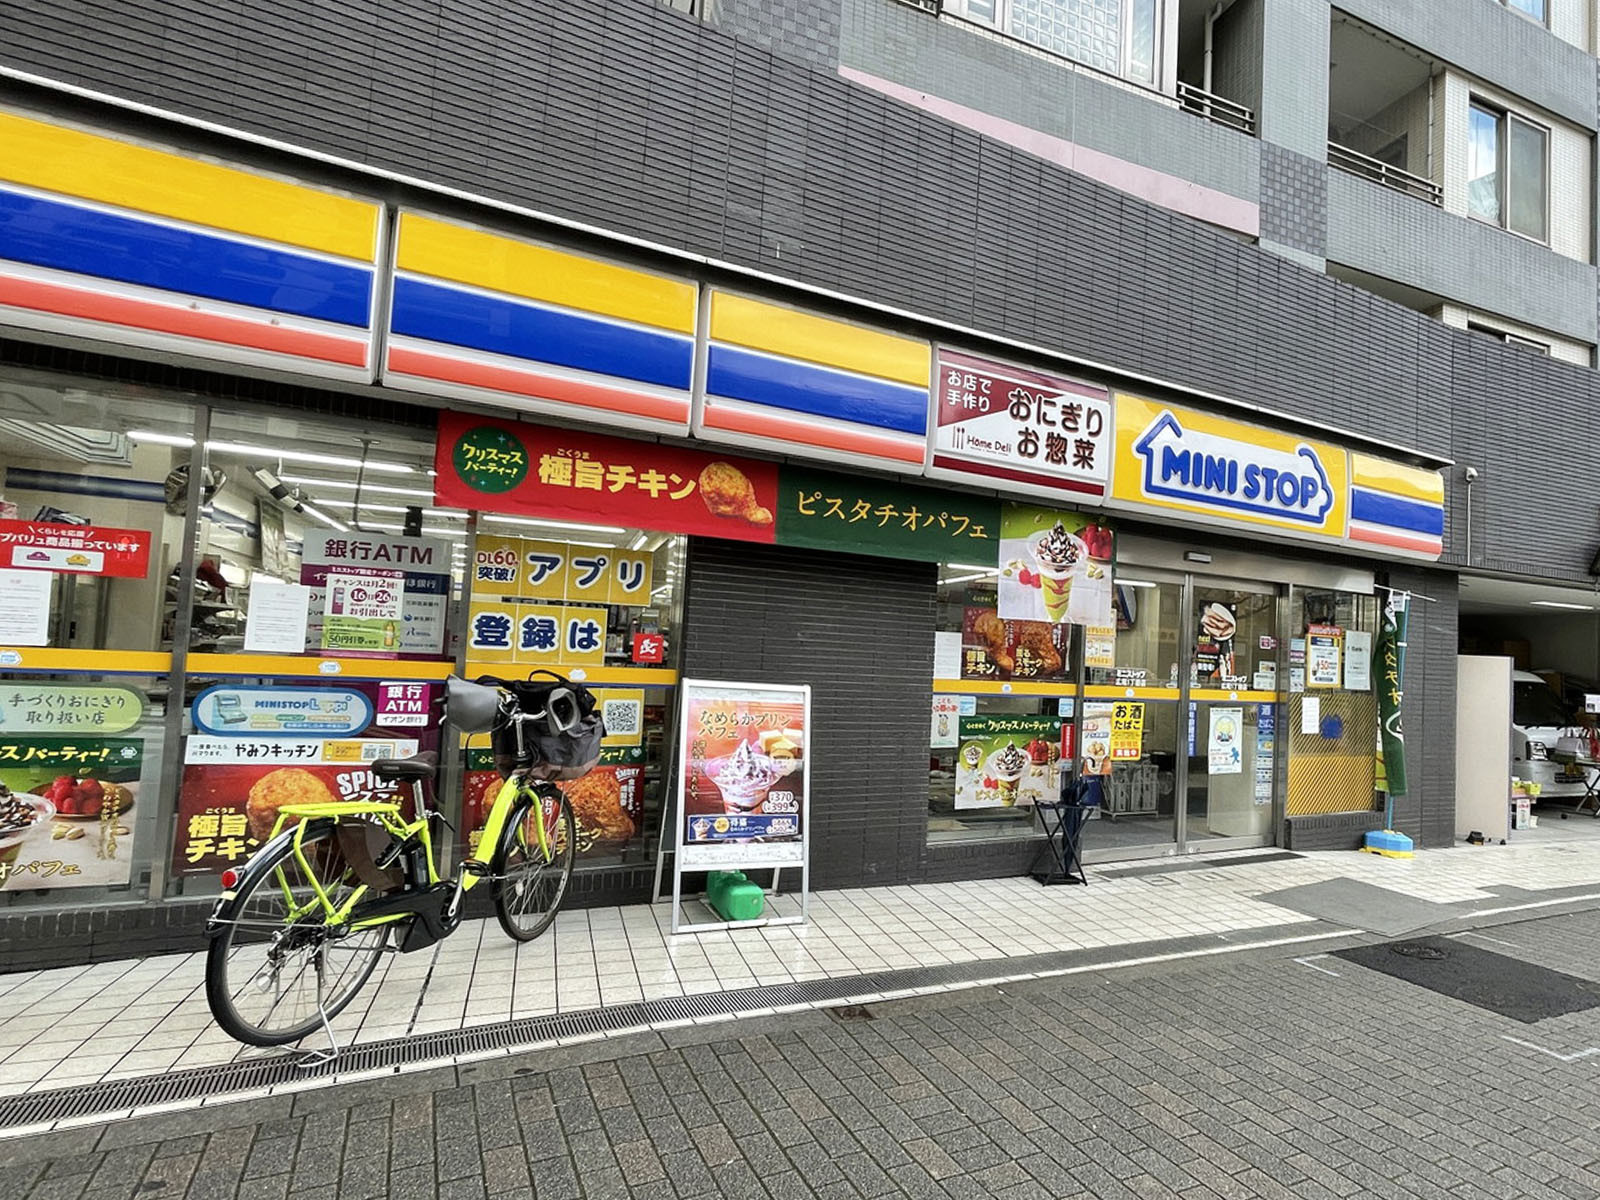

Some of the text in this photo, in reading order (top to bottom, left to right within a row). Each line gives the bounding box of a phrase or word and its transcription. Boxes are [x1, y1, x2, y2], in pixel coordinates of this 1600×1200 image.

[947, 370, 992, 395] お店で
[946, 390, 991, 413] 手作り
[1007, 388, 1104, 436] おにぎり
[966, 435, 993, 449] Home
[994, 440, 1012, 453] Deli
[1016, 426, 1096, 471] お惣菜
[462, 442, 524, 465] クリスマス
[556, 448, 590, 459] ごくうま
[538, 454, 697, 500] 極旨チキン
[1161, 444, 1320, 509] MINI STOP
[796, 490, 989, 539] ピスタチオパフェ
[478, 566, 516, 582] 突破!
[528, 553, 643, 591] アプリ
[474, 615, 600, 650] 登録は
[966, 663, 996, 675] チキン
[8, 693, 126, 709] 手づくりおにぎり
[387, 686, 422, 699] 銀行
[254, 699, 310, 710] MINISTOP
[385, 700, 422, 712] ATM
[1115, 704, 1143, 720] お酒
[25, 711, 105, 725] 取り扱い店
[382, 715, 423, 724] イオン銀行
[699, 710, 792, 727] なめらかプリン
[1113, 720, 1141, 730] たばこ
[699, 726, 739, 740] パフェ
[0, 745, 111, 763] スパーティー!
[235, 742, 319, 758] やみつキッチン
[187, 814, 249, 838] 極旨
